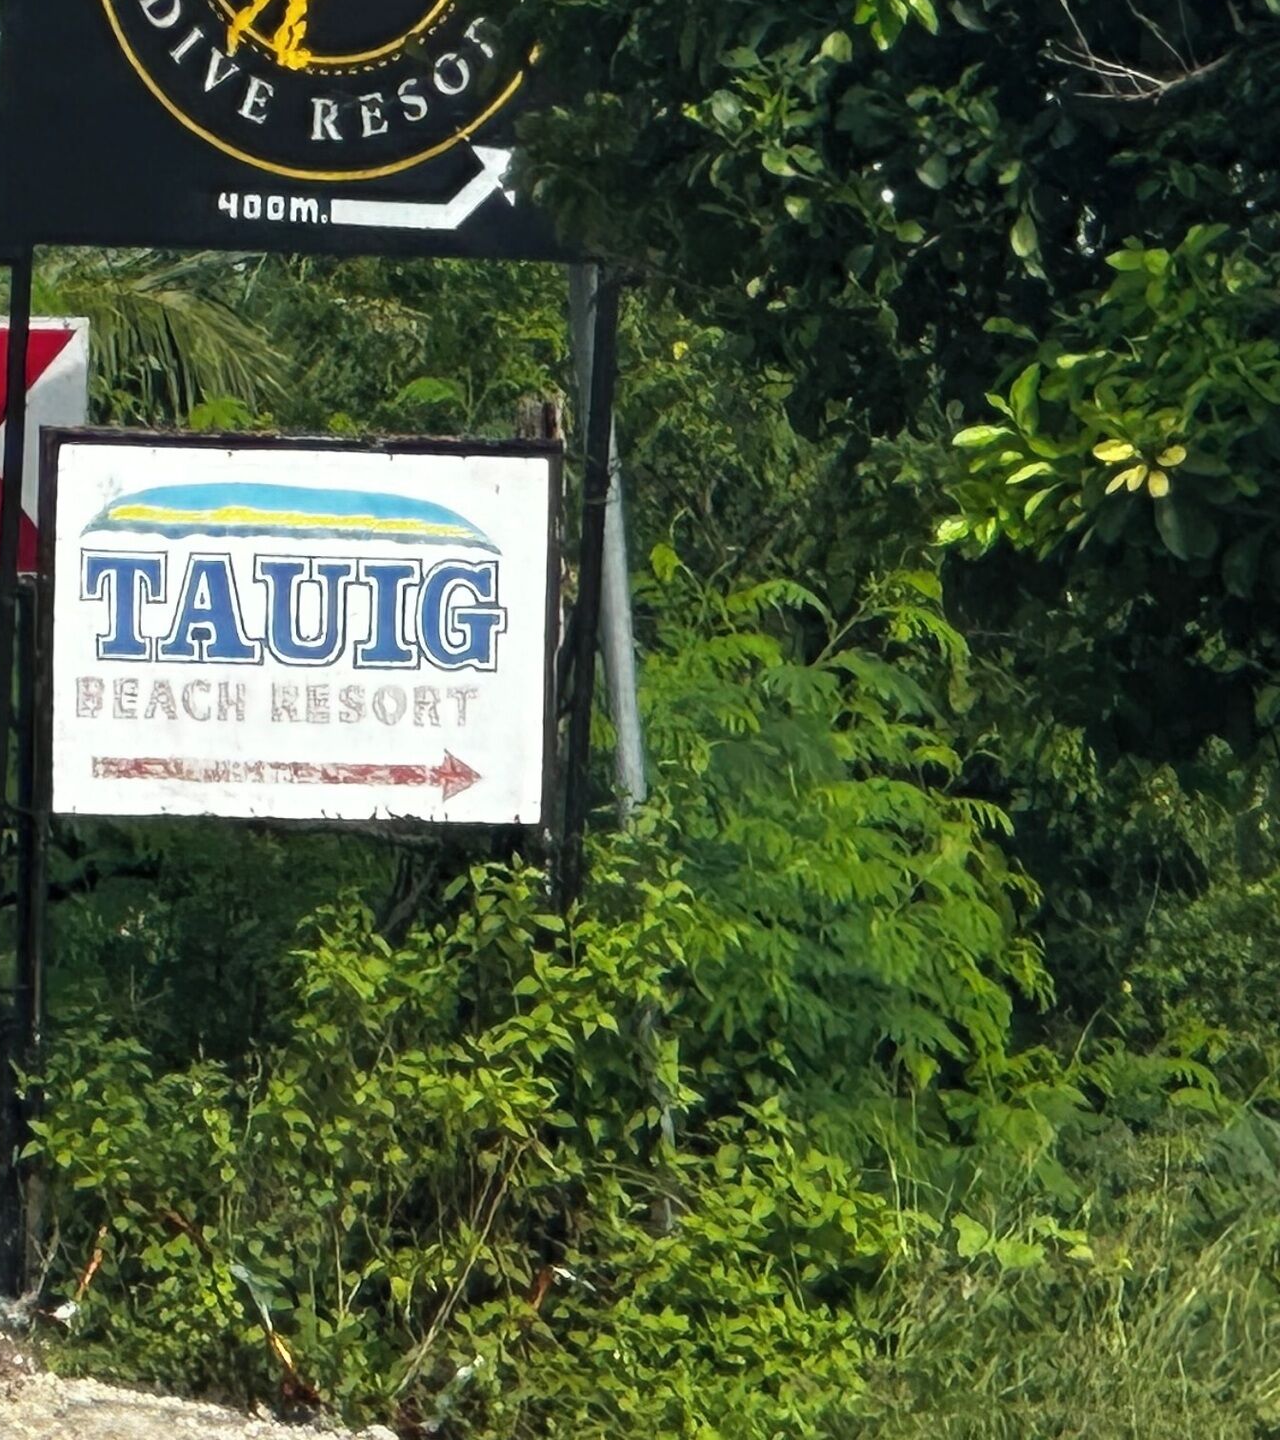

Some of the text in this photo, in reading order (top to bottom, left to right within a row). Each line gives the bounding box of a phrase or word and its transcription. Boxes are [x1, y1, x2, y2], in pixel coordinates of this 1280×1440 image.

[79, 547, 508, 673] TAUIG
[75, 675, 480, 728] BEACH RESORT
